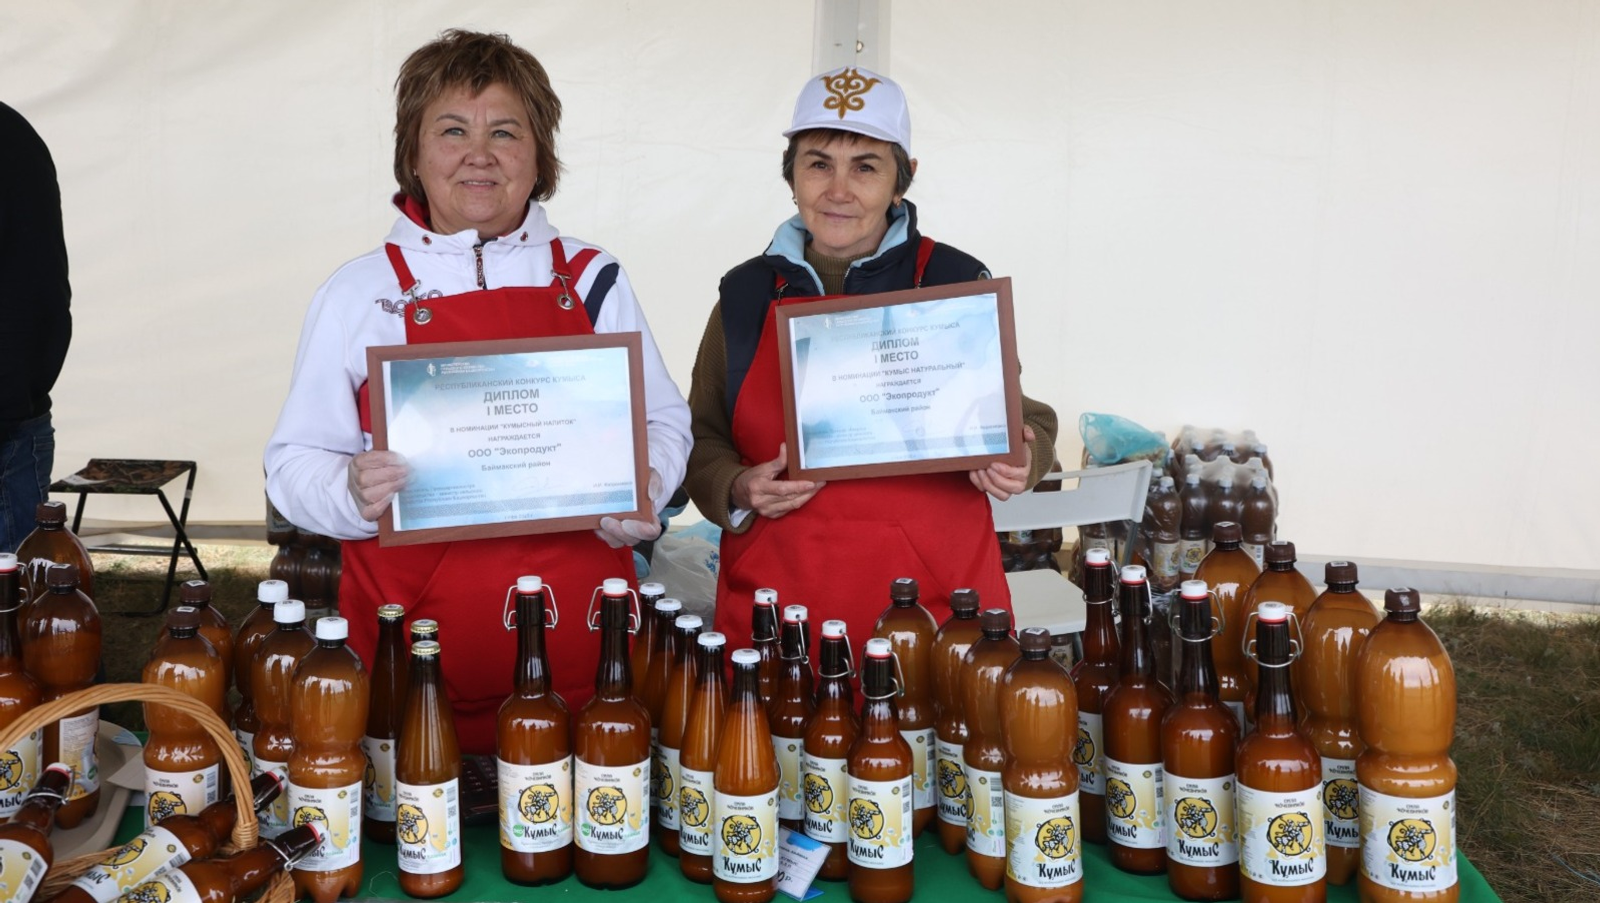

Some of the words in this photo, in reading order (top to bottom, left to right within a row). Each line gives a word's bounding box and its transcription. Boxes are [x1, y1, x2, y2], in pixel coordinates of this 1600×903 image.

[871, 337, 920, 351] ДИПЛОМ
[880, 350, 919, 363] МЕСТО
[434, 379, 514, 391] РЕСПУБЛИКАНСКИЙ
[515, 376, 551, 386] КОНКУРС
[553, 374, 586, 384] КУМЫСА
[483, 389, 540, 404] ДИПЛОМ
[860, 393, 880, 403] ООО
[494, 403, 539, 416] МЕСТО
[456, 424, 499, 433] НОМИНАЦИИ
[488, 432, 541, 442] НАГРАЖДАЕТСЯ
[468, 448, 492, 458] ООО
[494, 443, 562, 457] "Экопродукт"
[528, 460, 551, 469] район
